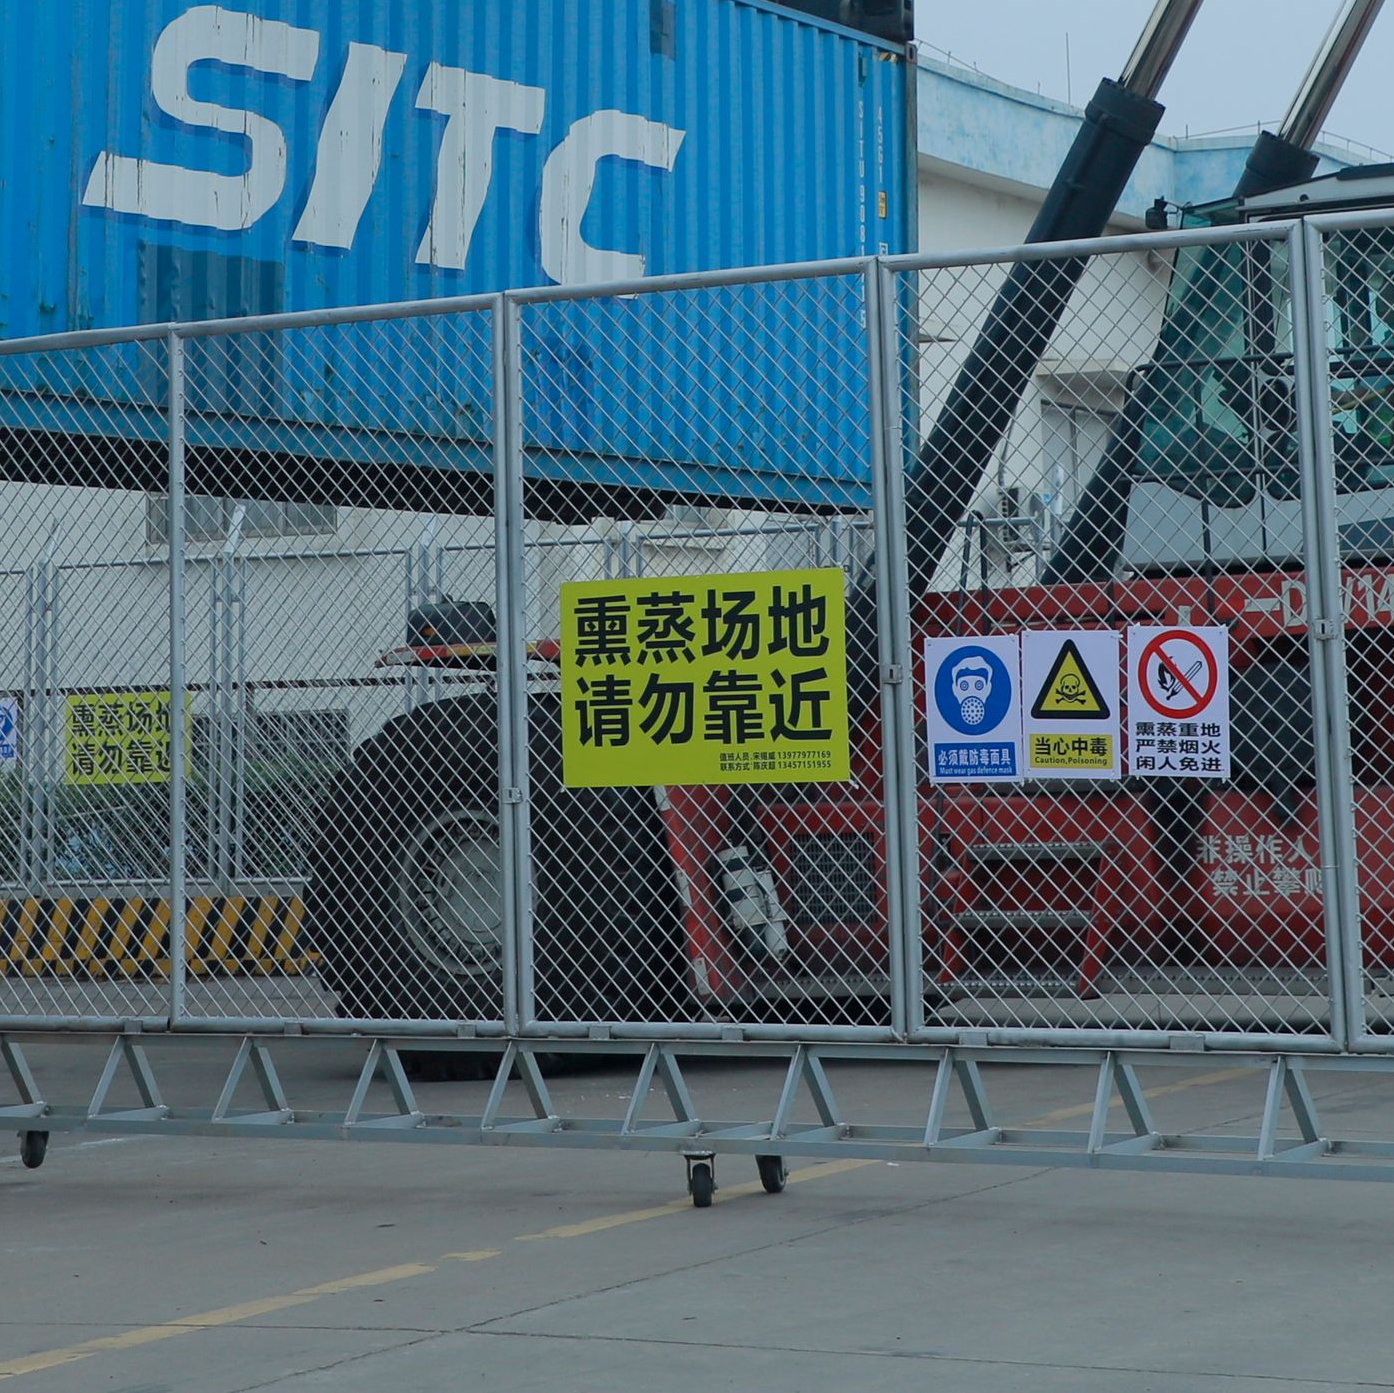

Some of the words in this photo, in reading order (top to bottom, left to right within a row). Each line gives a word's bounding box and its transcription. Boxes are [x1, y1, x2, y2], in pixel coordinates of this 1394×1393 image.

[81, 4, 687, 300] SITC
[573, 584, 830, 668] 熏蒸场地
[574, 667, 833, 747] 请勿靠近
[1135, 721, 1221, 737] 熏蒸重地
[1035, 737, 1108, 756] 当心中毒
[1135, 738, 1221, 754] 严禁烟火
[938, 748, 1011, 766] 必须戴防毒面具
[1136, 755, 1222, 771] 闲人免进
